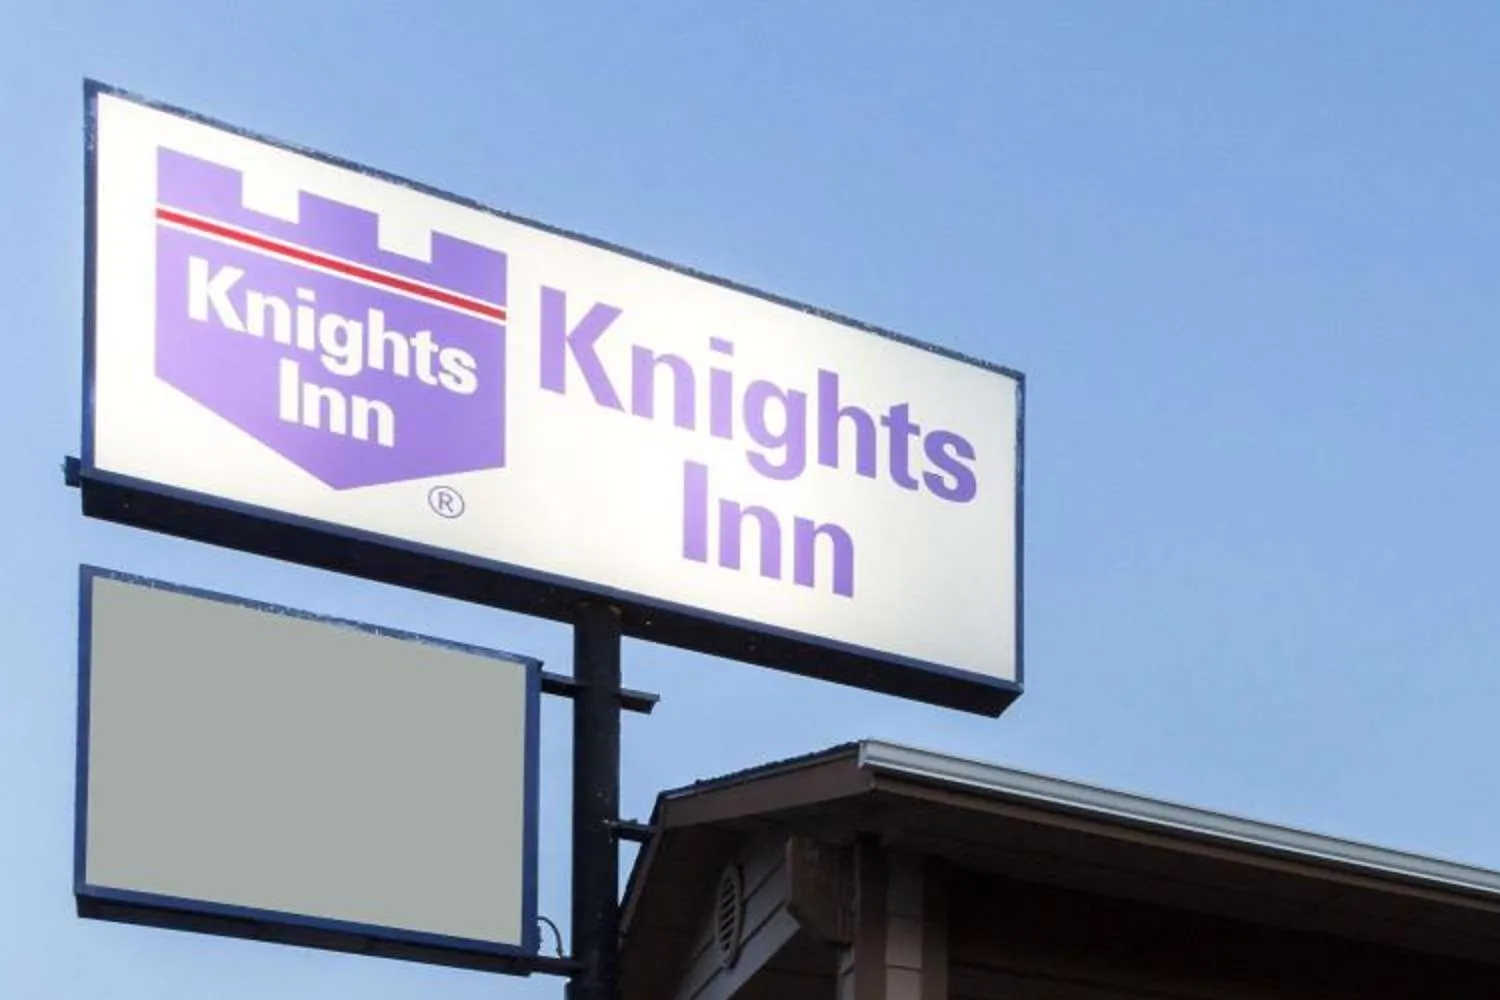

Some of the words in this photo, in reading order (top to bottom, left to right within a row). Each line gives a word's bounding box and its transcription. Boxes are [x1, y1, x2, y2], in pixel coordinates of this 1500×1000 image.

[186, 255, 479, 395] Knights
[279, 357, 395, 447] Inn
[540, 287, 977, 502] Knights
[682, 463, 855, 598] Inn
